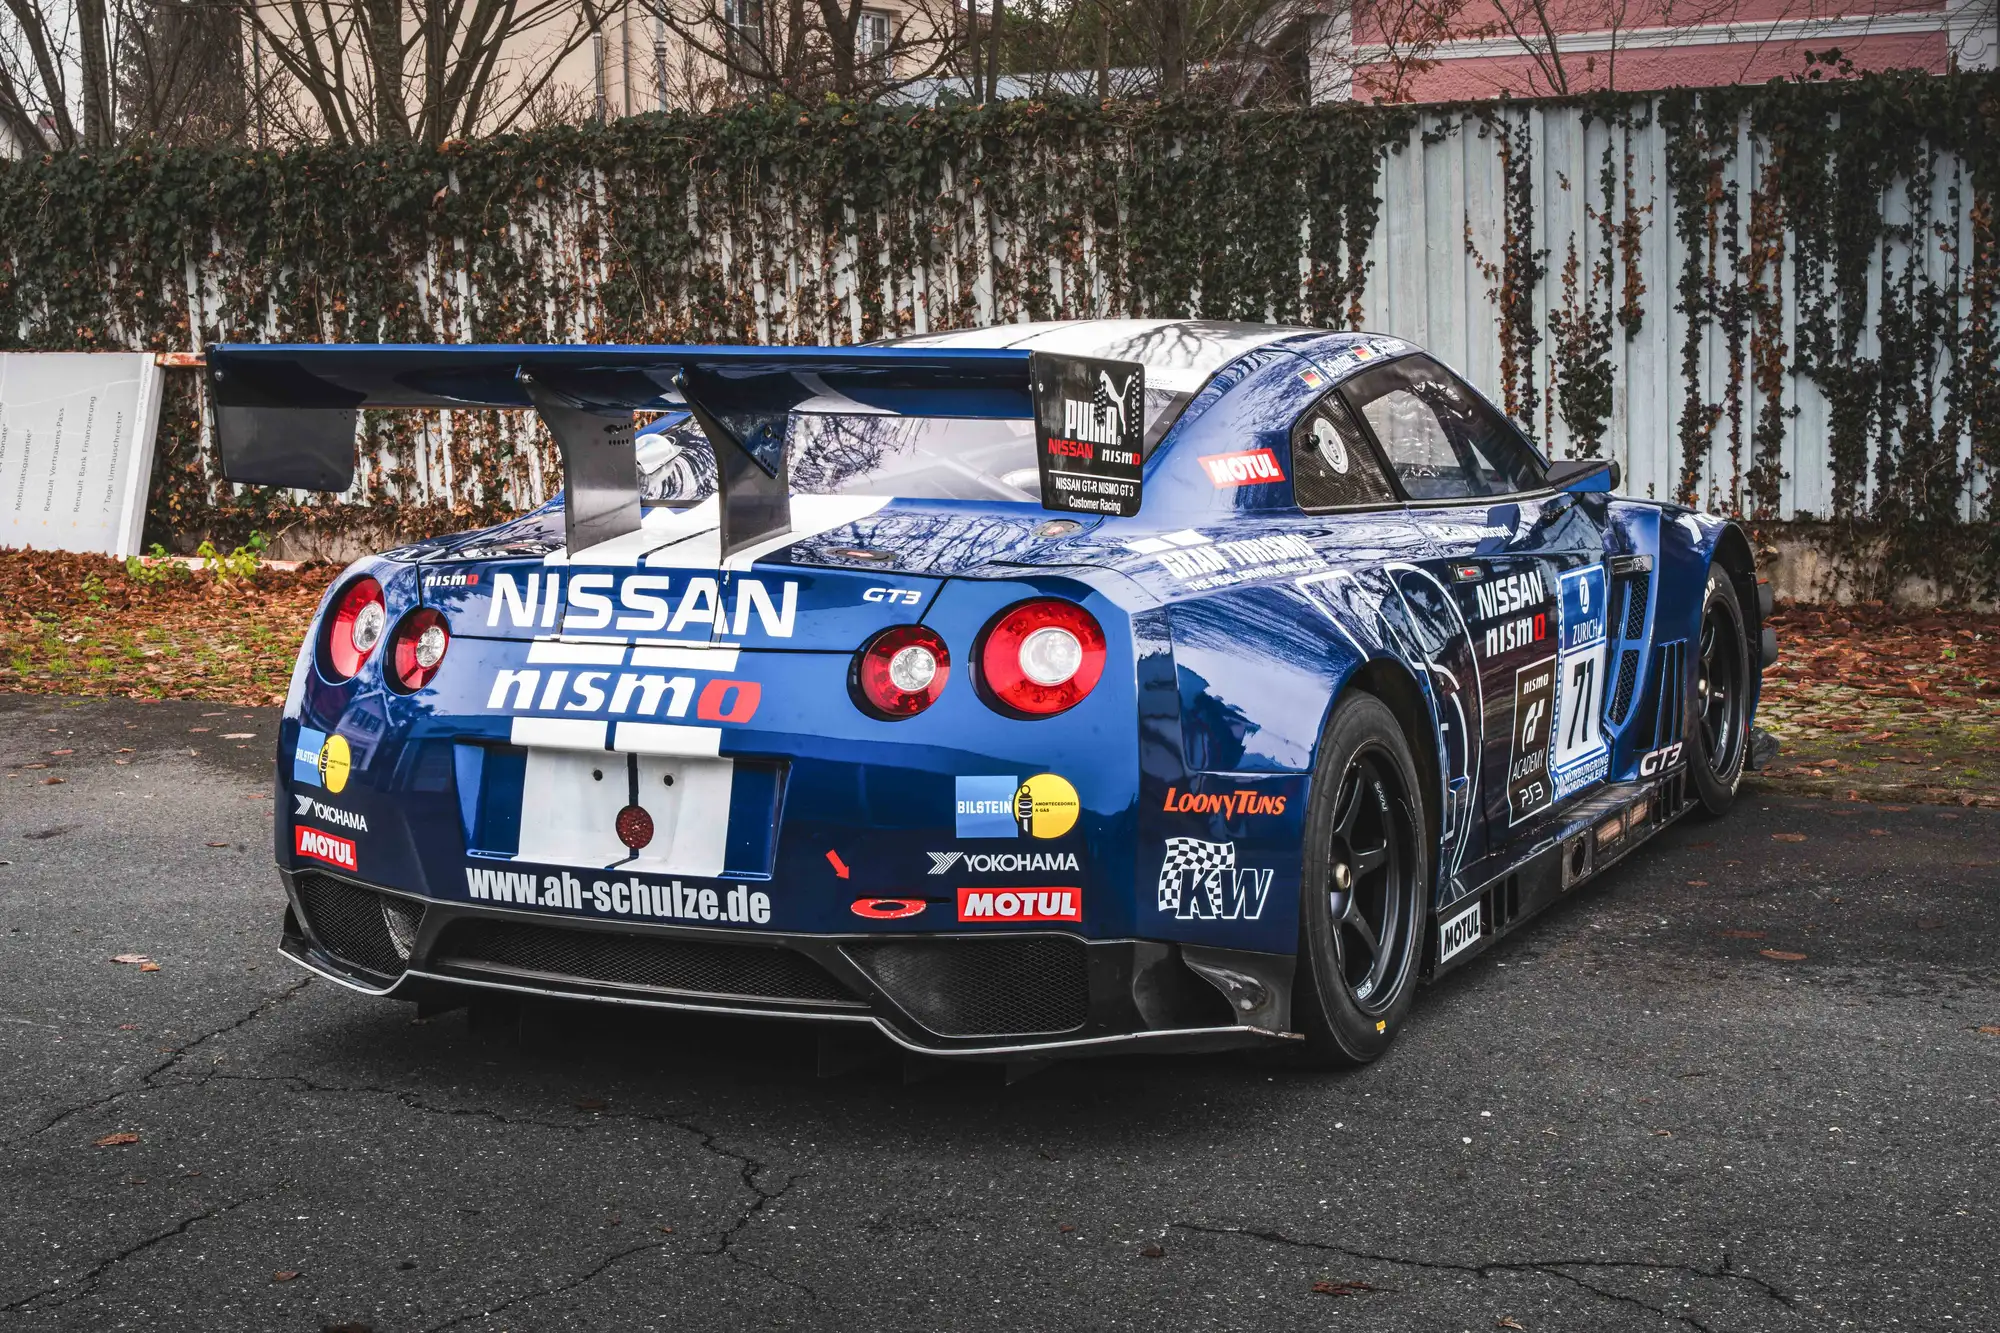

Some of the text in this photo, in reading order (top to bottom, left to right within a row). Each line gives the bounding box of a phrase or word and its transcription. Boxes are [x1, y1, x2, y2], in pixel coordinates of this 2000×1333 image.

[73, 396, 97, 513] Renault Bank Finanzierung
[1048, 438, 1094, 460] NISSAN
[1102, 449, 1141, 466] nismo
[1208, 455, 1280, 484] MOTUL
[44, 479, 55, 512] Renault
[104, 481, 114, 504] Tage
[1055, 476, 1134, 498] NISSAN GT-R NISMO GT 3
[1068, 495, 1121, 514] Customer Racing
[1156, 533, 1316, 580] GRAN TURISMO
[425, 574, 479, 587] nismo
[862, 586, 923, 606] GT3
[1185, 578, 1213, 591] THE
[1207, 573, 1240, 586] REAL
[1476, 569, 1544, 621] NISSAN
[486, 573, 799, 638] NISSAN
[1486, 613, 1546, 658] nismo
[1572, 618, 1598, 646] ZURICH
[486, 668, 763, 723] nismo
[1567, 657, 1595, 750] 71
[1511, 748, 1546, 783] ACADEMY
[1640, 742, 1683, 777] GT3
[1519, 781, 1544, 809] PS3
[1564, 764, 1609, 795] NORDSCHLEIFE
[312, 800, 368, 832] YOKOHAMA
[957, 800, 1013, 814] BILSTEIN
[301, 831, 354, 866] MOTUL
[963, 853, 1080, 872] YOKOHAMA
[465, 867, 771, 924] www.ah-schulze.de
[964, 892, 1077, 917] MOTUL
[1175, 868, 1275, 920] KW
[1443, 909, 1480, 957] MOTUL
